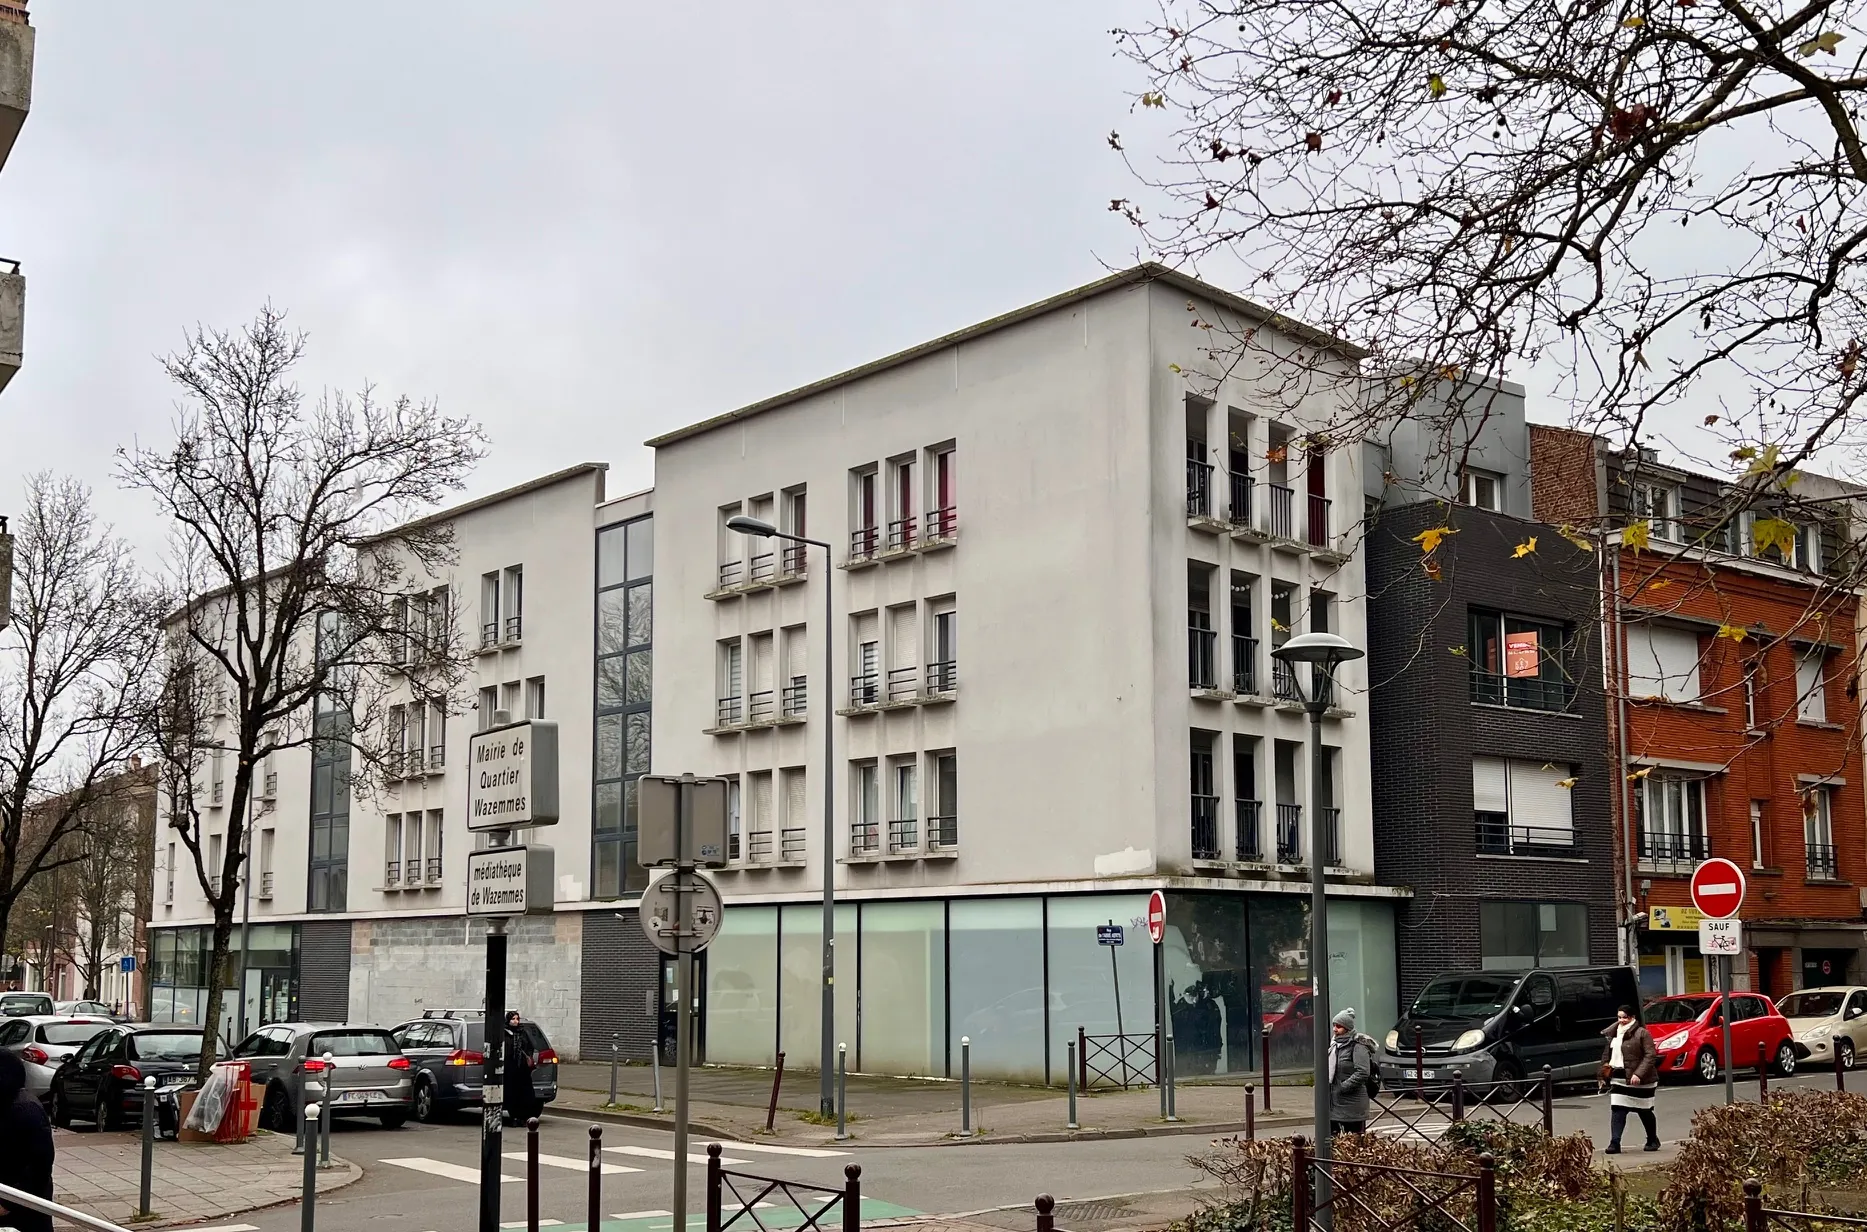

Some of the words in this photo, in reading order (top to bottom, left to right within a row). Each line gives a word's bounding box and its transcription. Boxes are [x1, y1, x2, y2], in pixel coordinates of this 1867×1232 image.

[477, 742, 506, 763] Mairie
[512, 737, 524, 757] de
[480, 767, 520, 790] Quartier
[474, 796, 526, 817] Wazemmes
[474, 860, 522, 883] médiathèque
[471, 890, 480, 906] de
[482, 886, 524, 905] Wazemmes
[1708, 922, 1730, 931] SAUF
